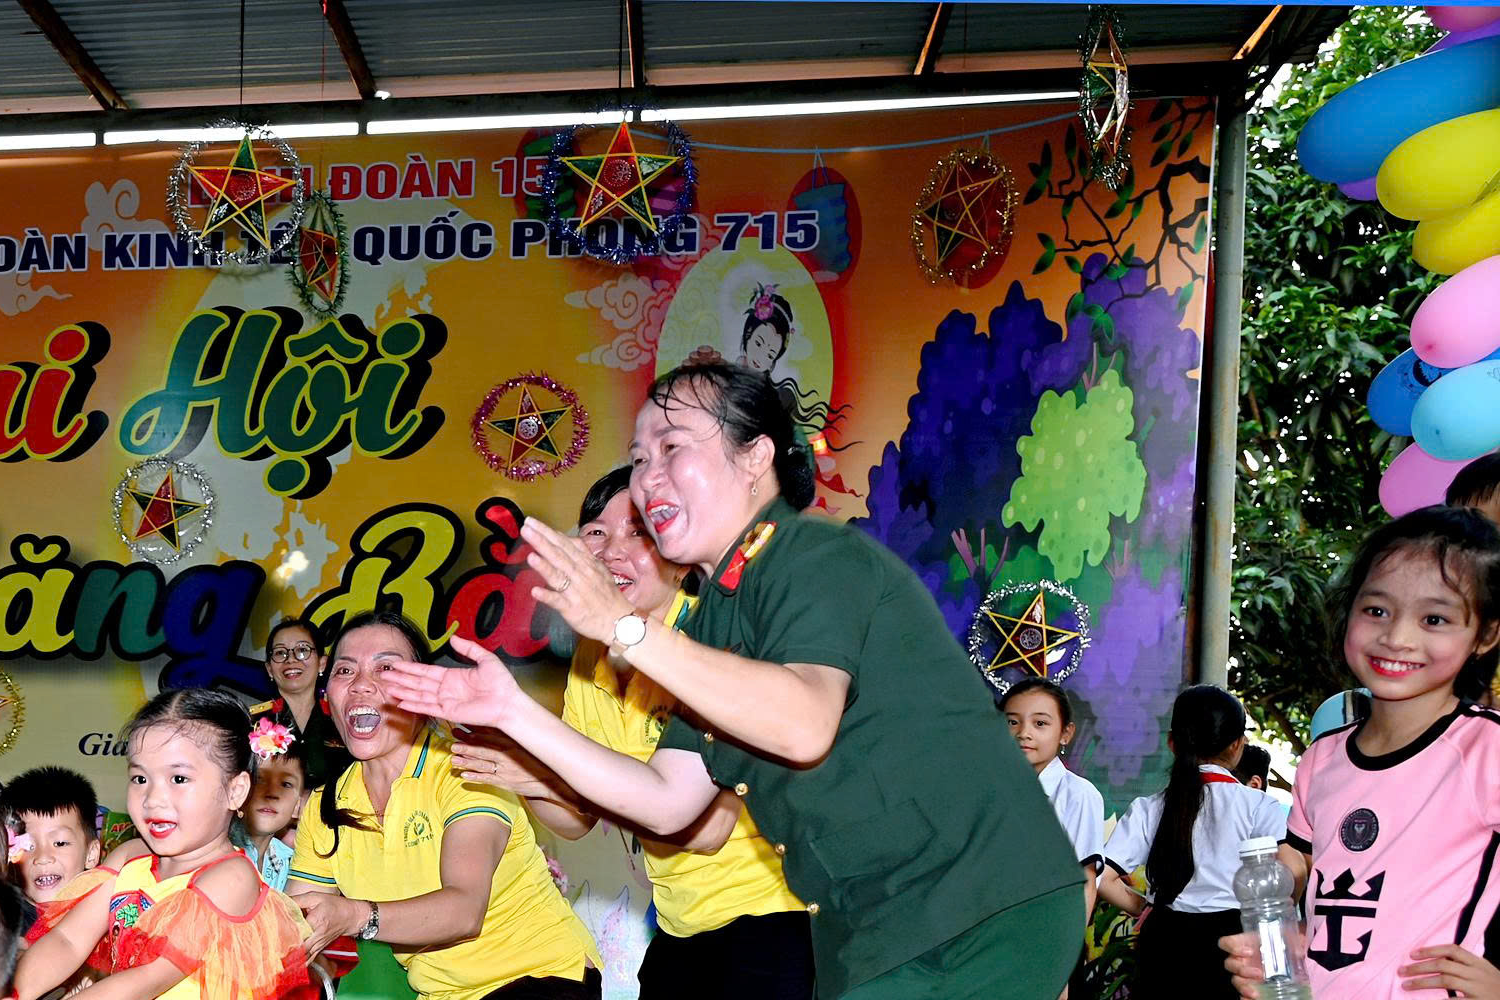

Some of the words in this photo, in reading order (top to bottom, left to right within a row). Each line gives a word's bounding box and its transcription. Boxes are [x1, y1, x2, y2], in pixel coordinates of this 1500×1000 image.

[329, 152, 476, 201] ĐOÀN
[492, 156, 556, 198] 15
[352, 210, 494, 266] QUỐC
[715, 210, 820, 252] 715
[119, 309, 430, 498] Hội
[304, 496, 576, 666] Rằ
